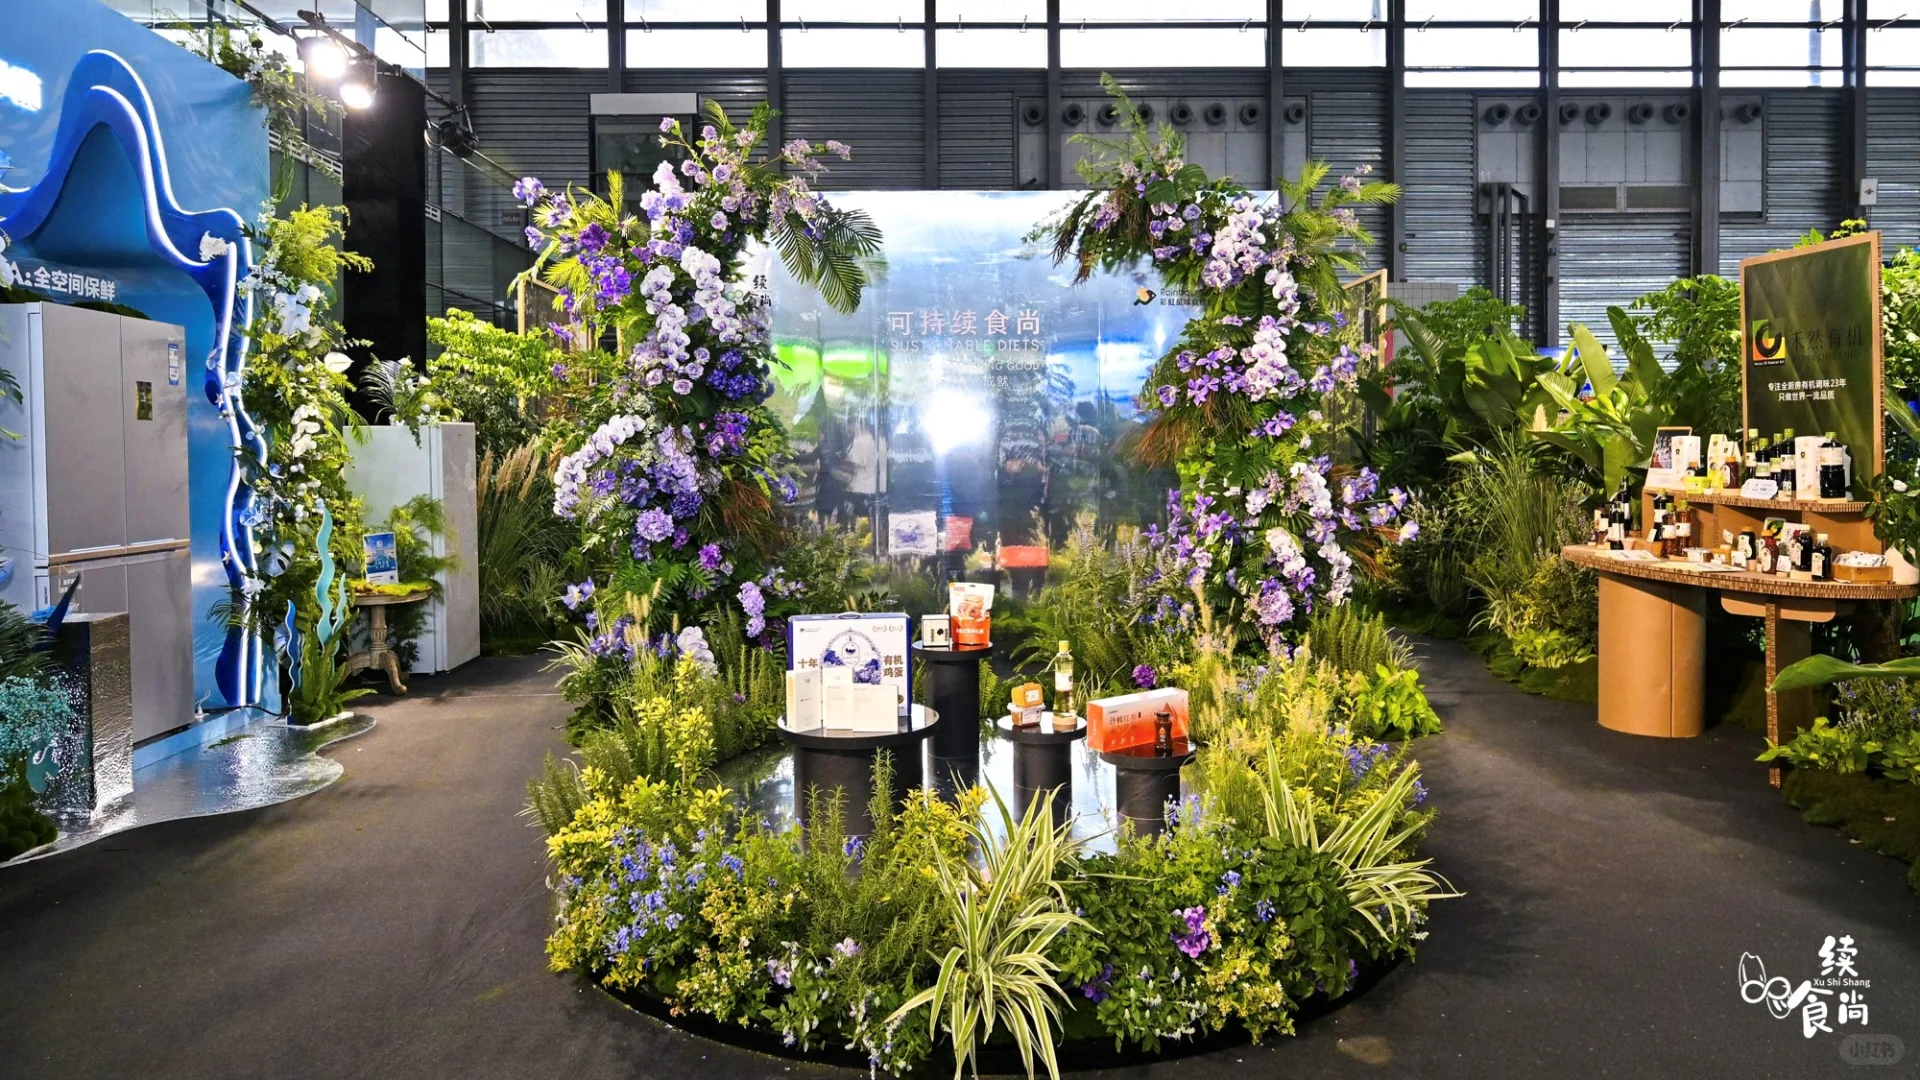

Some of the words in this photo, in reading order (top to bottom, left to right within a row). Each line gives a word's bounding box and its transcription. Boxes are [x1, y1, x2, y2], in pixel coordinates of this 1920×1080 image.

[889, 309, 1040, 335] 可持续食尚
[1790, 324, 1864, 352] 禾然有机
[997, 338, 1040, 352] DIETS
[1006, 362, 1040, 371] GOOD
[797, 658, 819, 669] 十年
[883, 655, 904, 666] 有机
[883, 667, 904, 678] 鸡蛋
